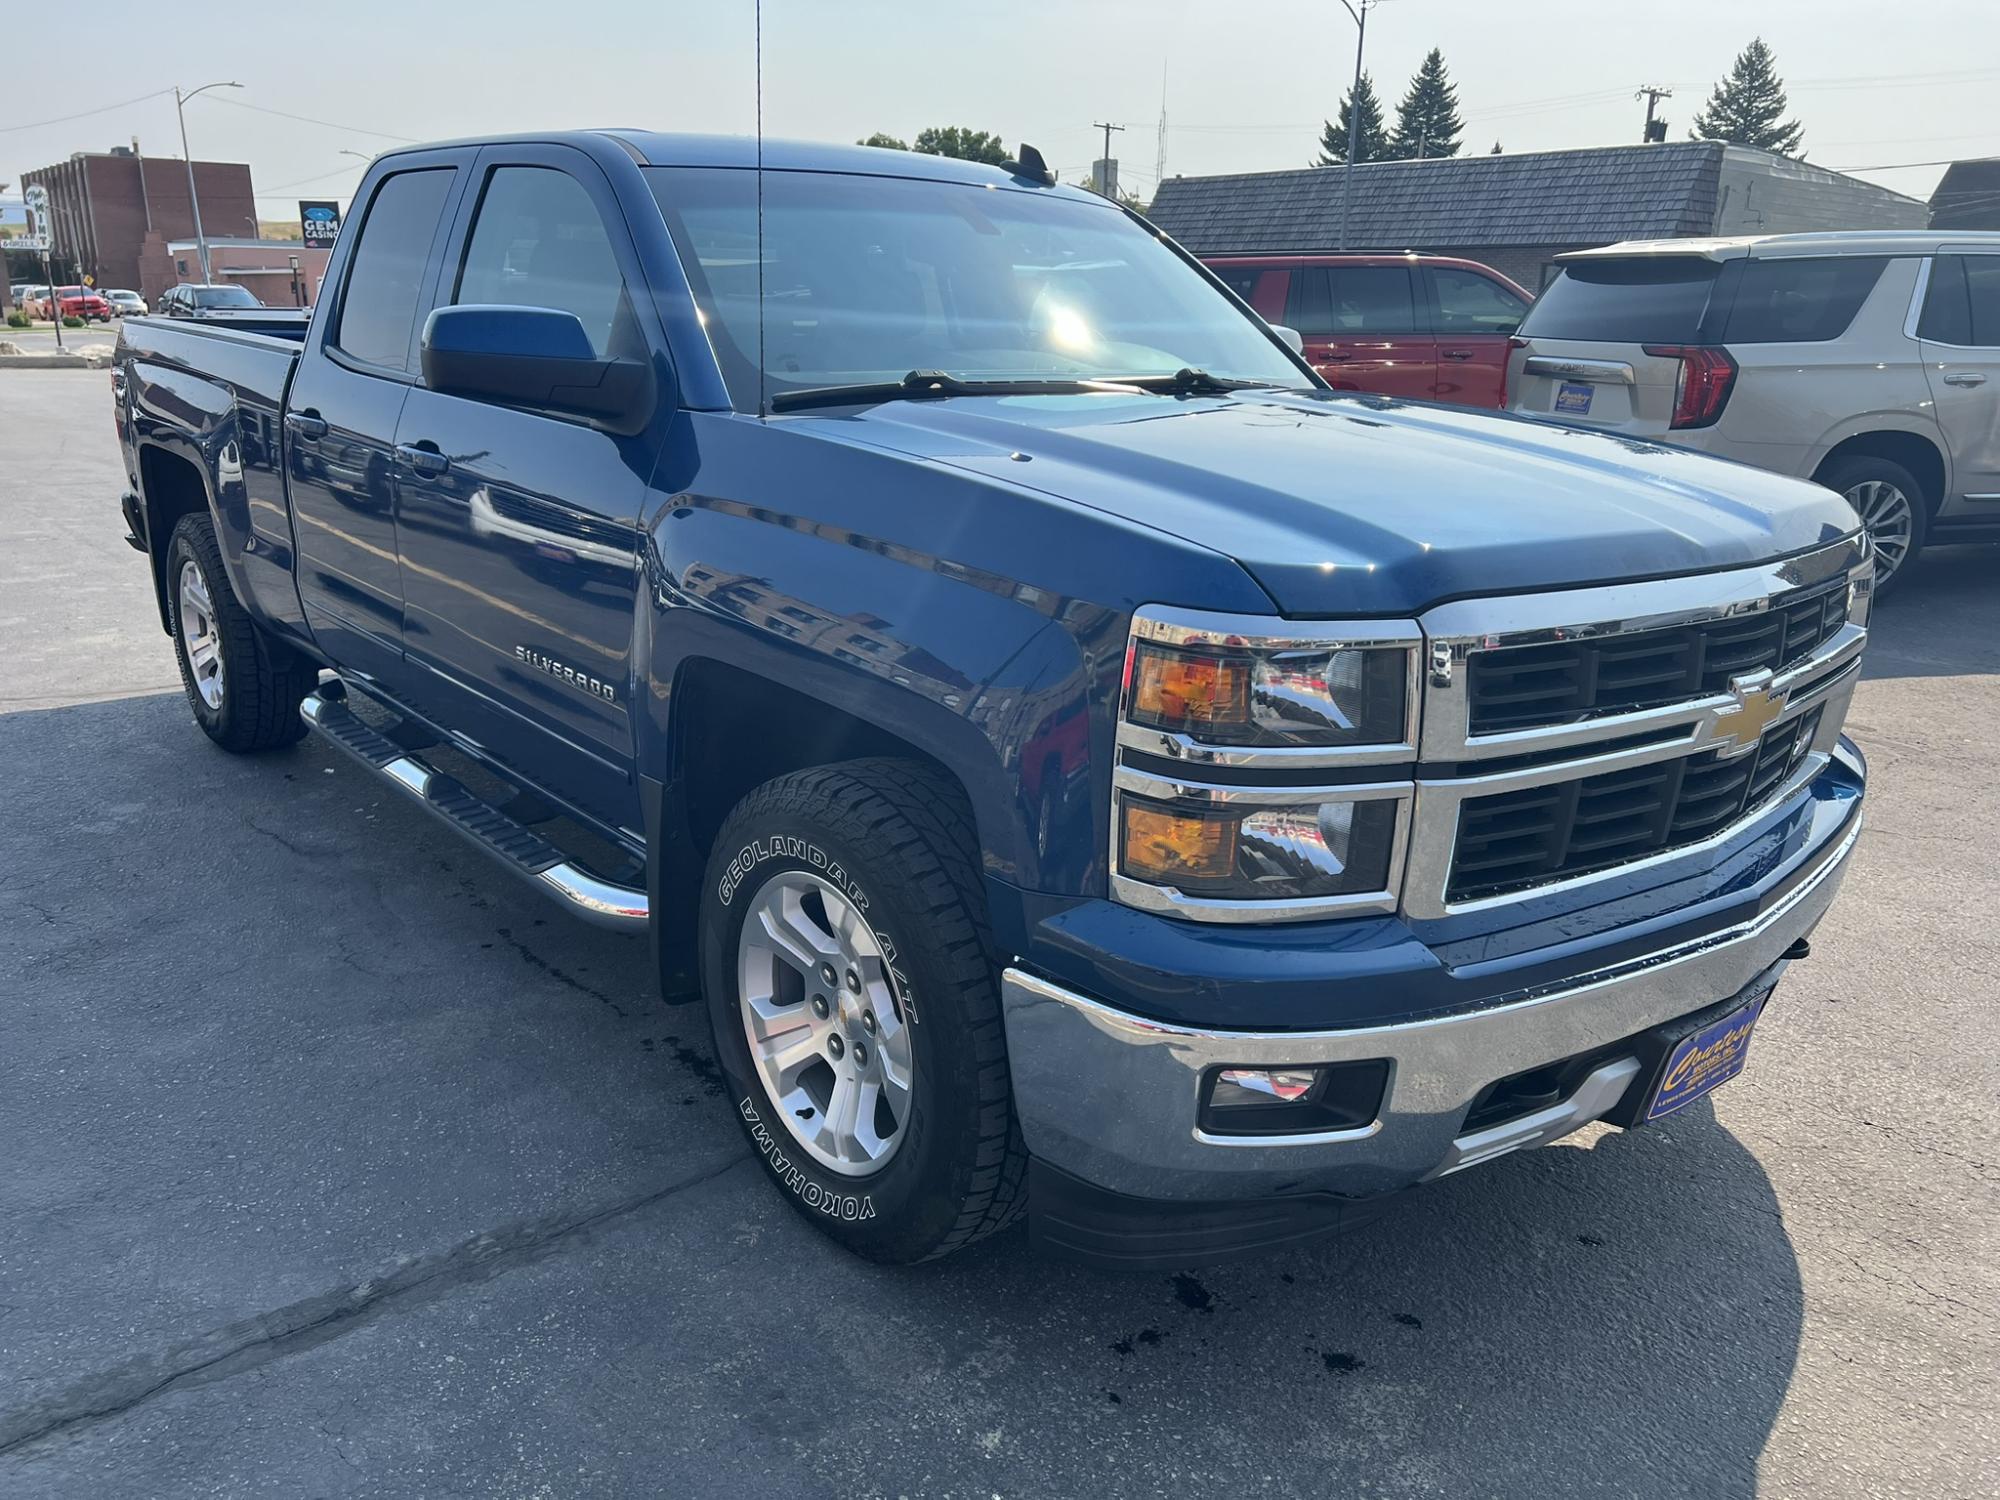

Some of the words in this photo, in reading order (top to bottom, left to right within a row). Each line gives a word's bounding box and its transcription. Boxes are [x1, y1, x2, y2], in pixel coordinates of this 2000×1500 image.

[305, 221, 338, 231] GEM
[515, 645, 616, 701] SILVERADO
[718, 835, 870, 914] GEOLANDAR
[876, 932, 920, 1025] A/T
[1664, 1022, 1754, 1091] Courtesy
[739, 1096, 876, 1222] YOKOHAMA
